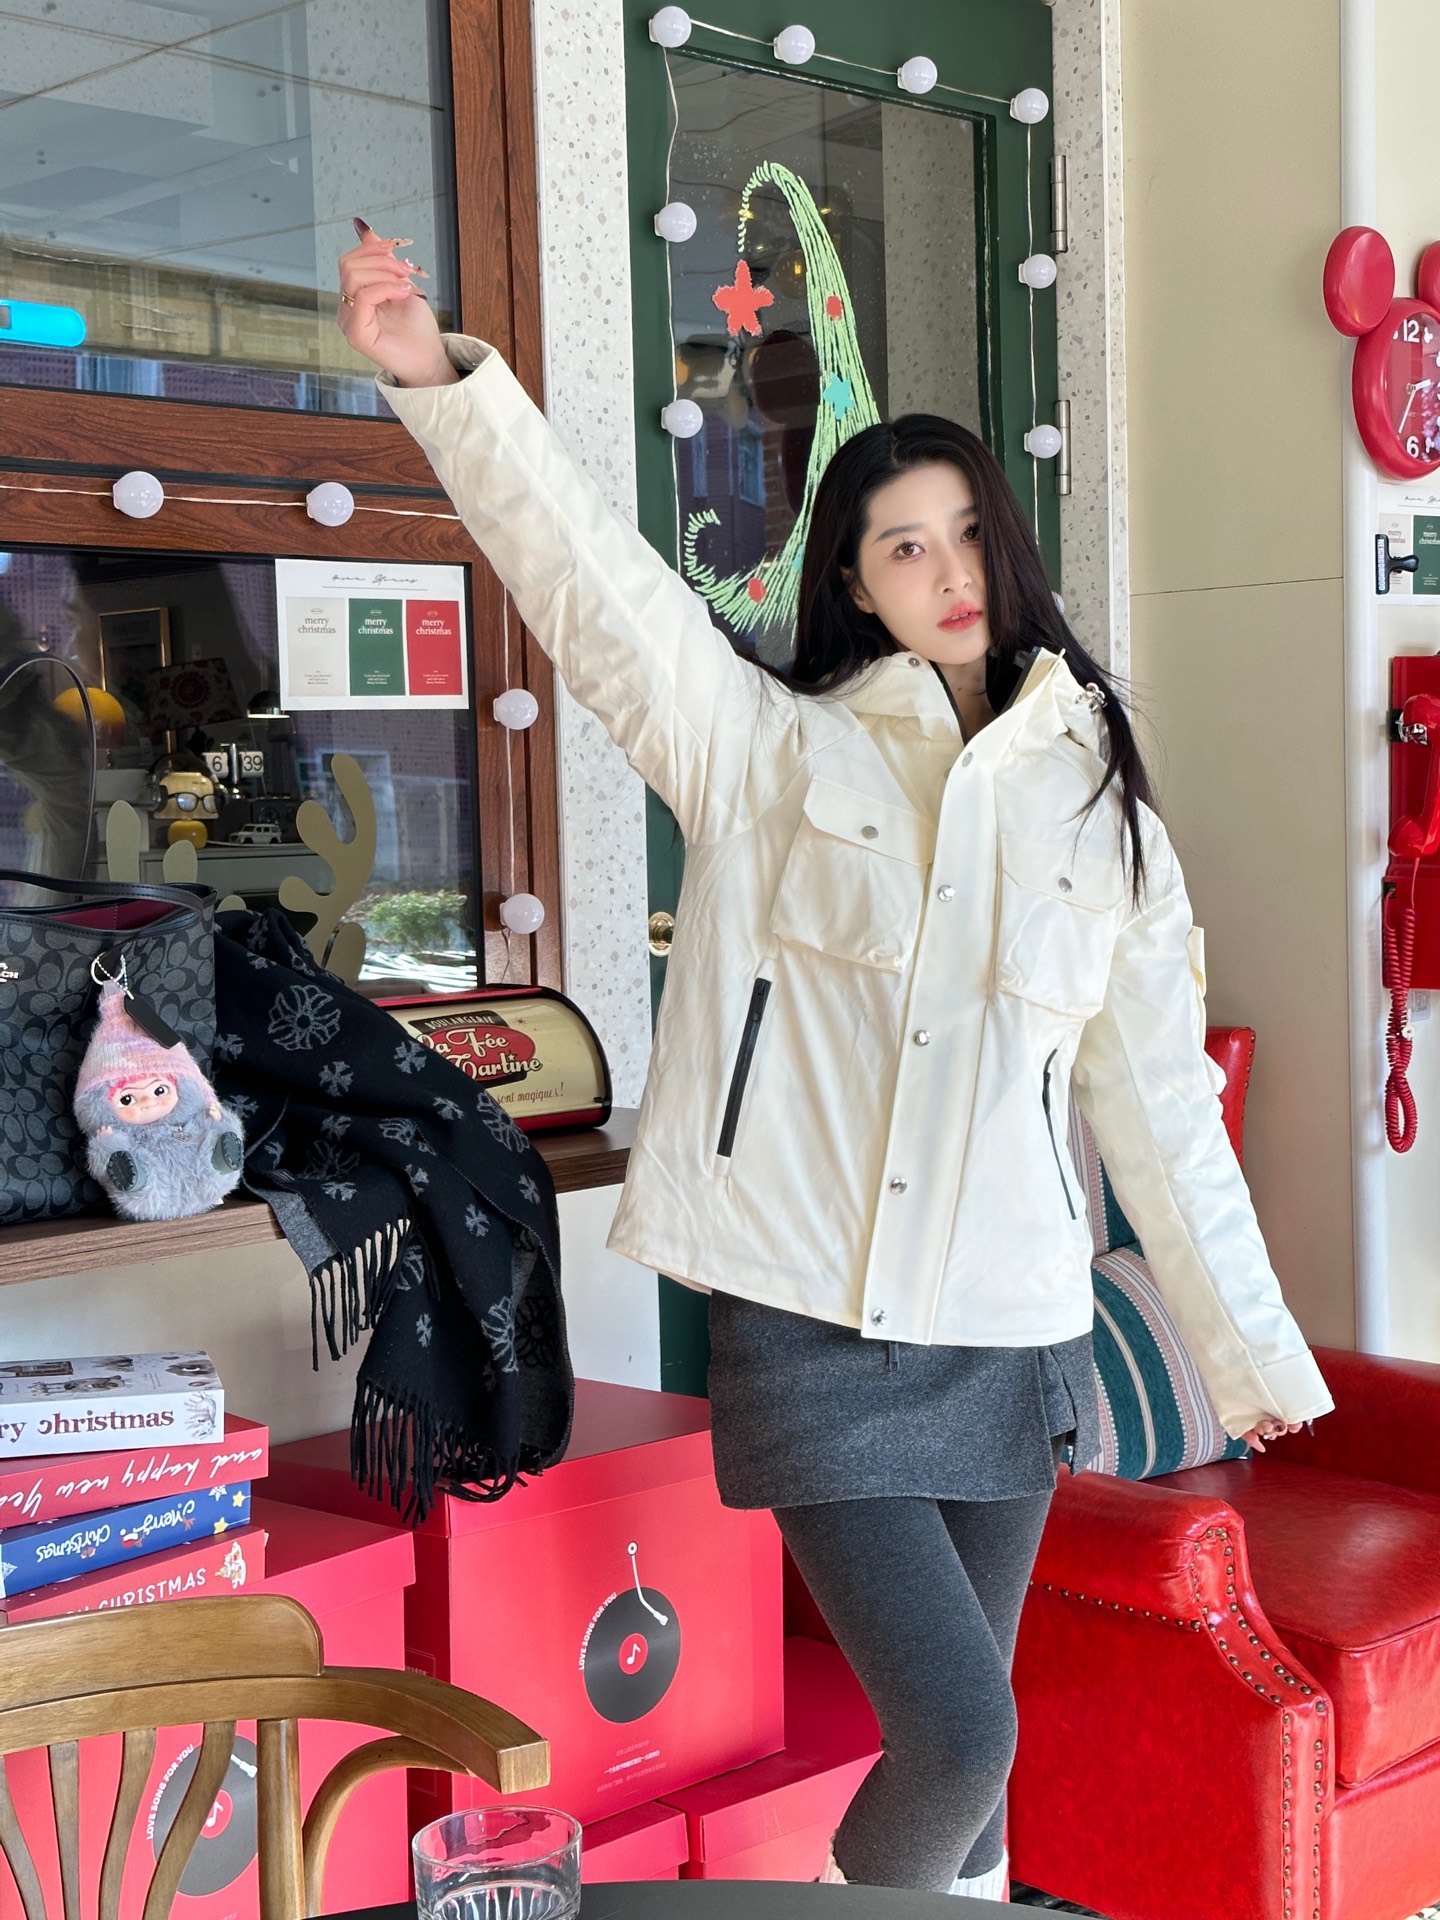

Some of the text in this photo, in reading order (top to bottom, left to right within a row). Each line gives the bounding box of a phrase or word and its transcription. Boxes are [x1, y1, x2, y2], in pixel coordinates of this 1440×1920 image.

[1403, 318, 1420, 343] 12
[1406, 435, 1419, 458] 6
[297, 624, 337, 634] christmas
[305, 617, 329, 626] merry
[358, 625, 393, 634] christmas
[365, 618, 387, 626] merry
[416, 626, 451, 635] christmas
[422, 619, 445, 627] merry
[213, 755, 263, 772] 6 39
[424, 1015, 496, 1030] BOULANGERIE
[121, 1453, 200, 1486] happy
[209, 1448, 263, 1479] and
[55, 1475, 109, 1498] new
[36, 1499, 195, 1563] Merry Christmas
[578, 1592, 618, 1671] LOVE SONG FOR YOU
[146, 1743, 195, 1840] LOVE SONG FOR YOU
